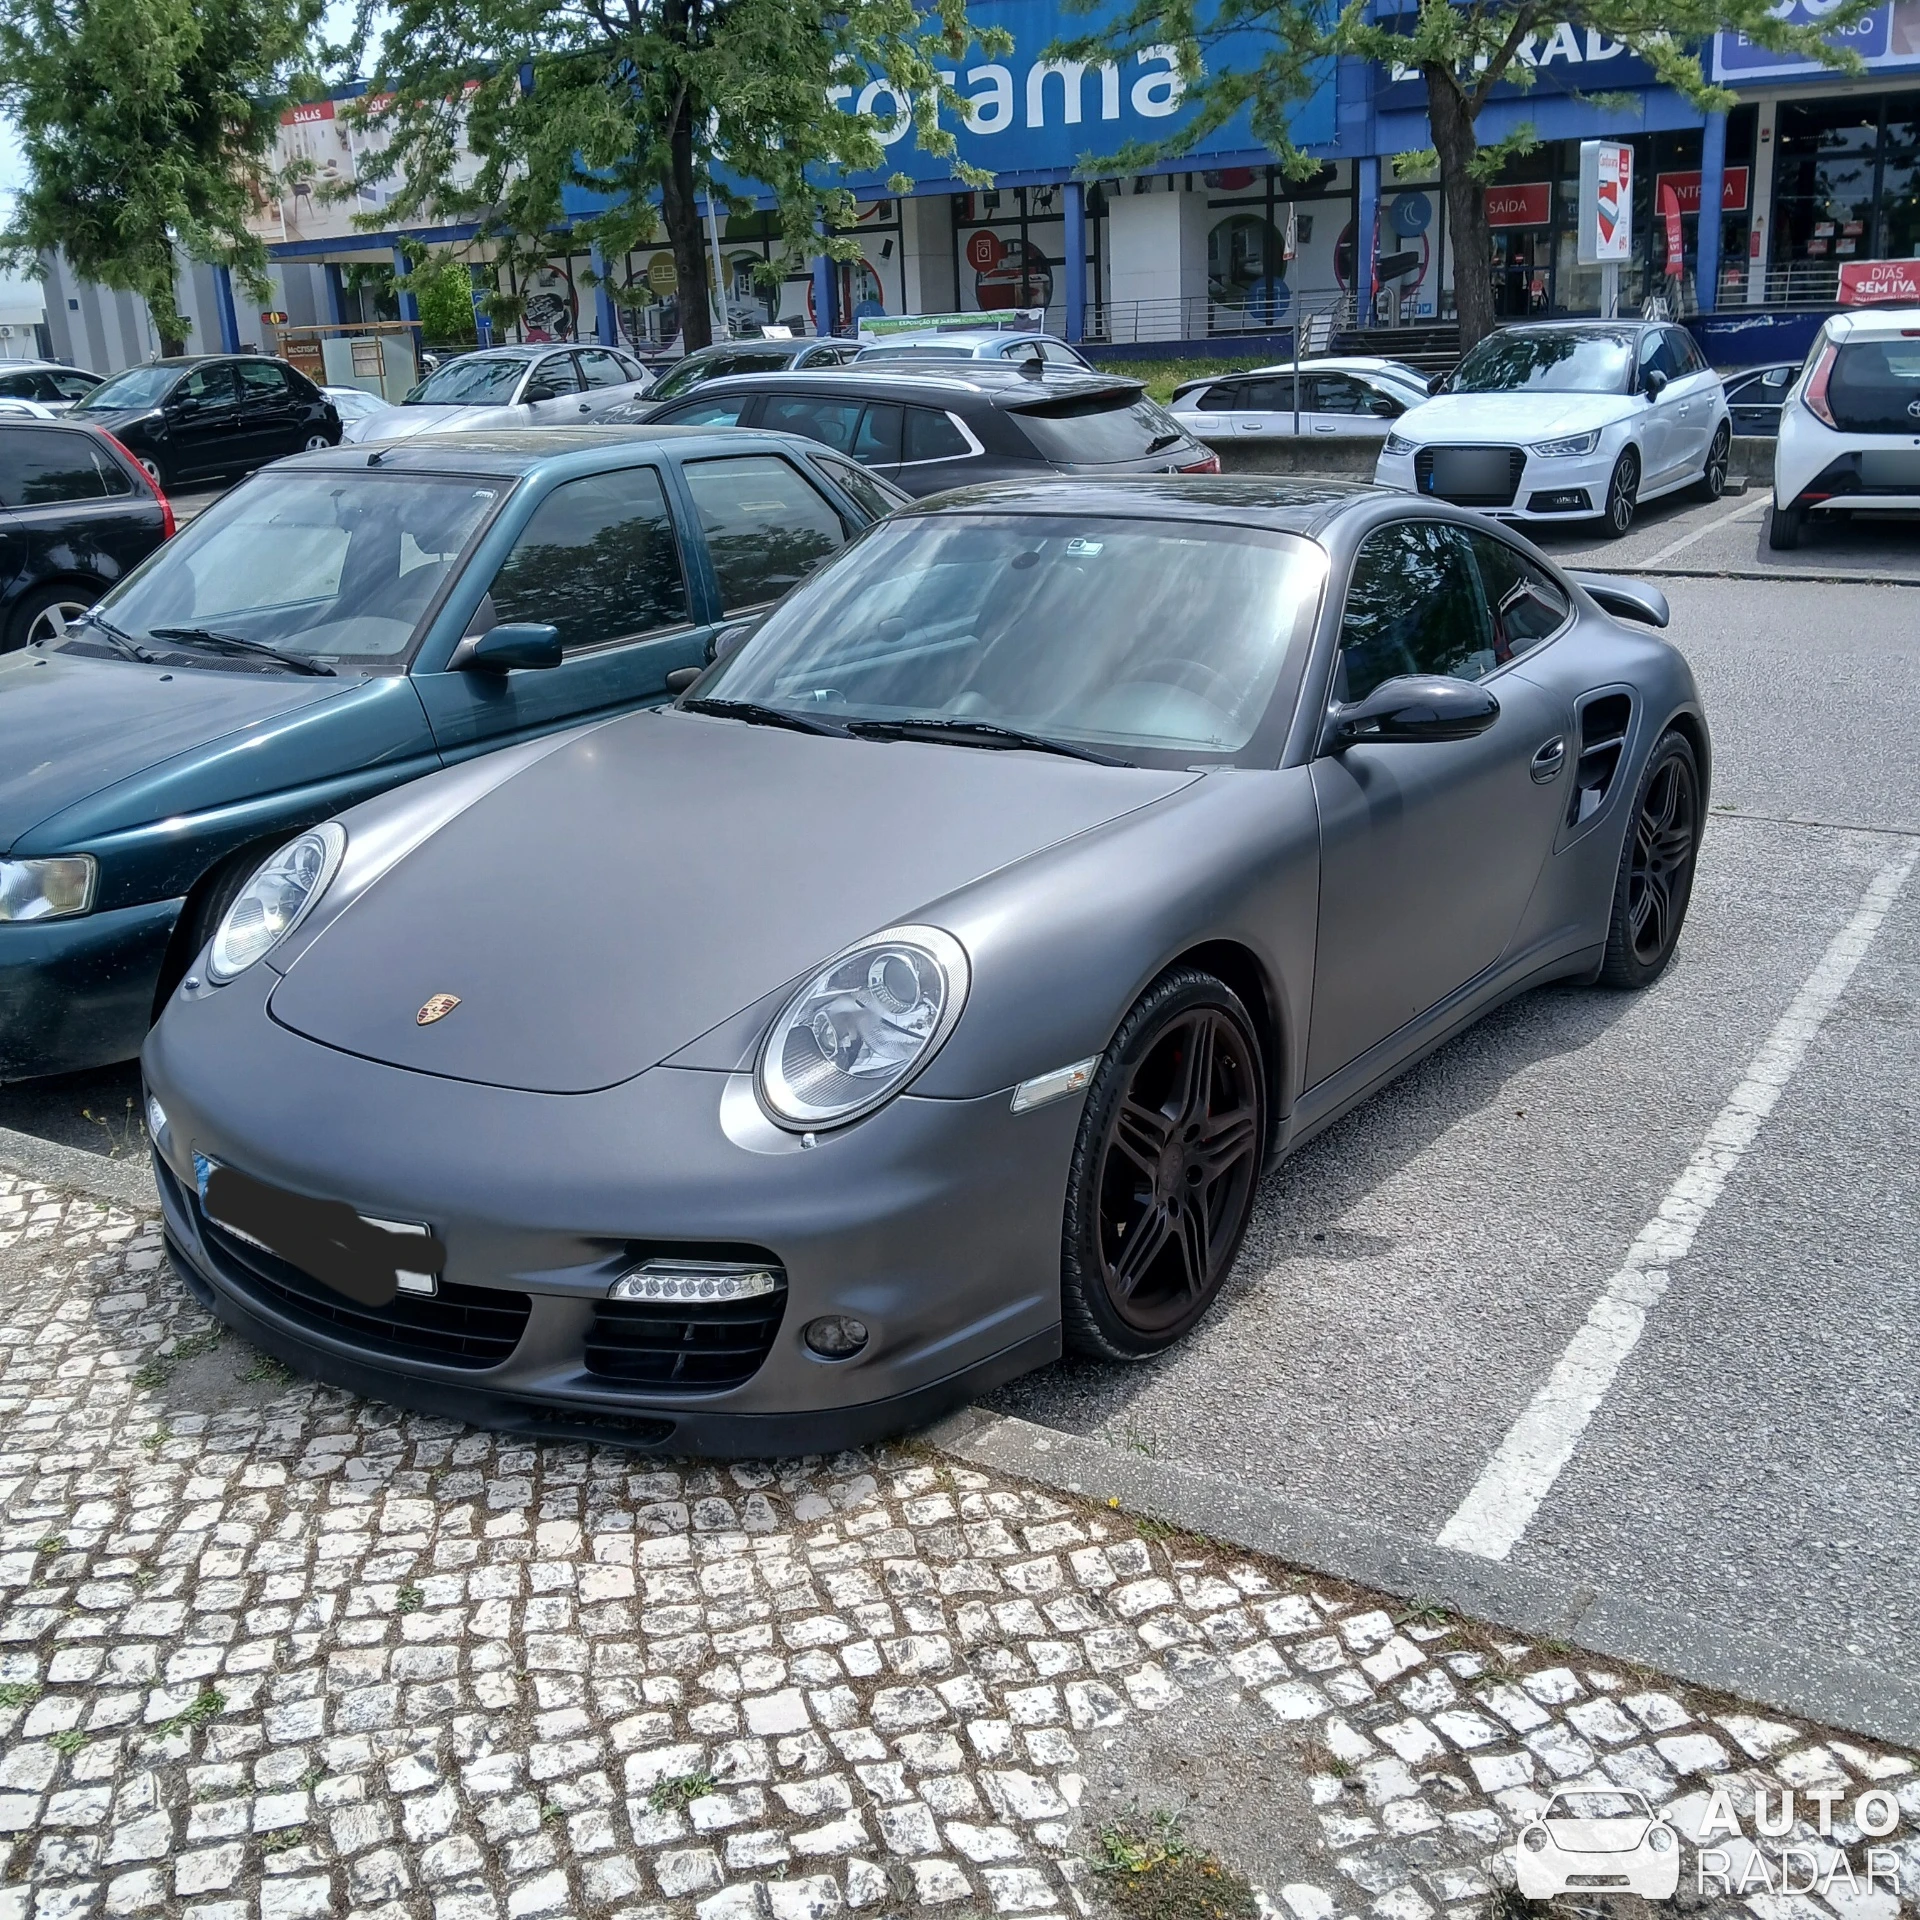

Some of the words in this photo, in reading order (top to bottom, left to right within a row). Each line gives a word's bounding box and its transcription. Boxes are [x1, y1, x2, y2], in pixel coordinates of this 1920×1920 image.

[1391, 22, 1672, 82] TRAD
[697, 43, 1192, 163] forama
[294, 109, 321, 122] SALAS
[1489, 199, 1527, 214] SAÍDA
[1872, 267, 1904, 280] DIAS
[1856, 280, 1889, 293] SEM
[1892, 280, 1917, 293] IVA
